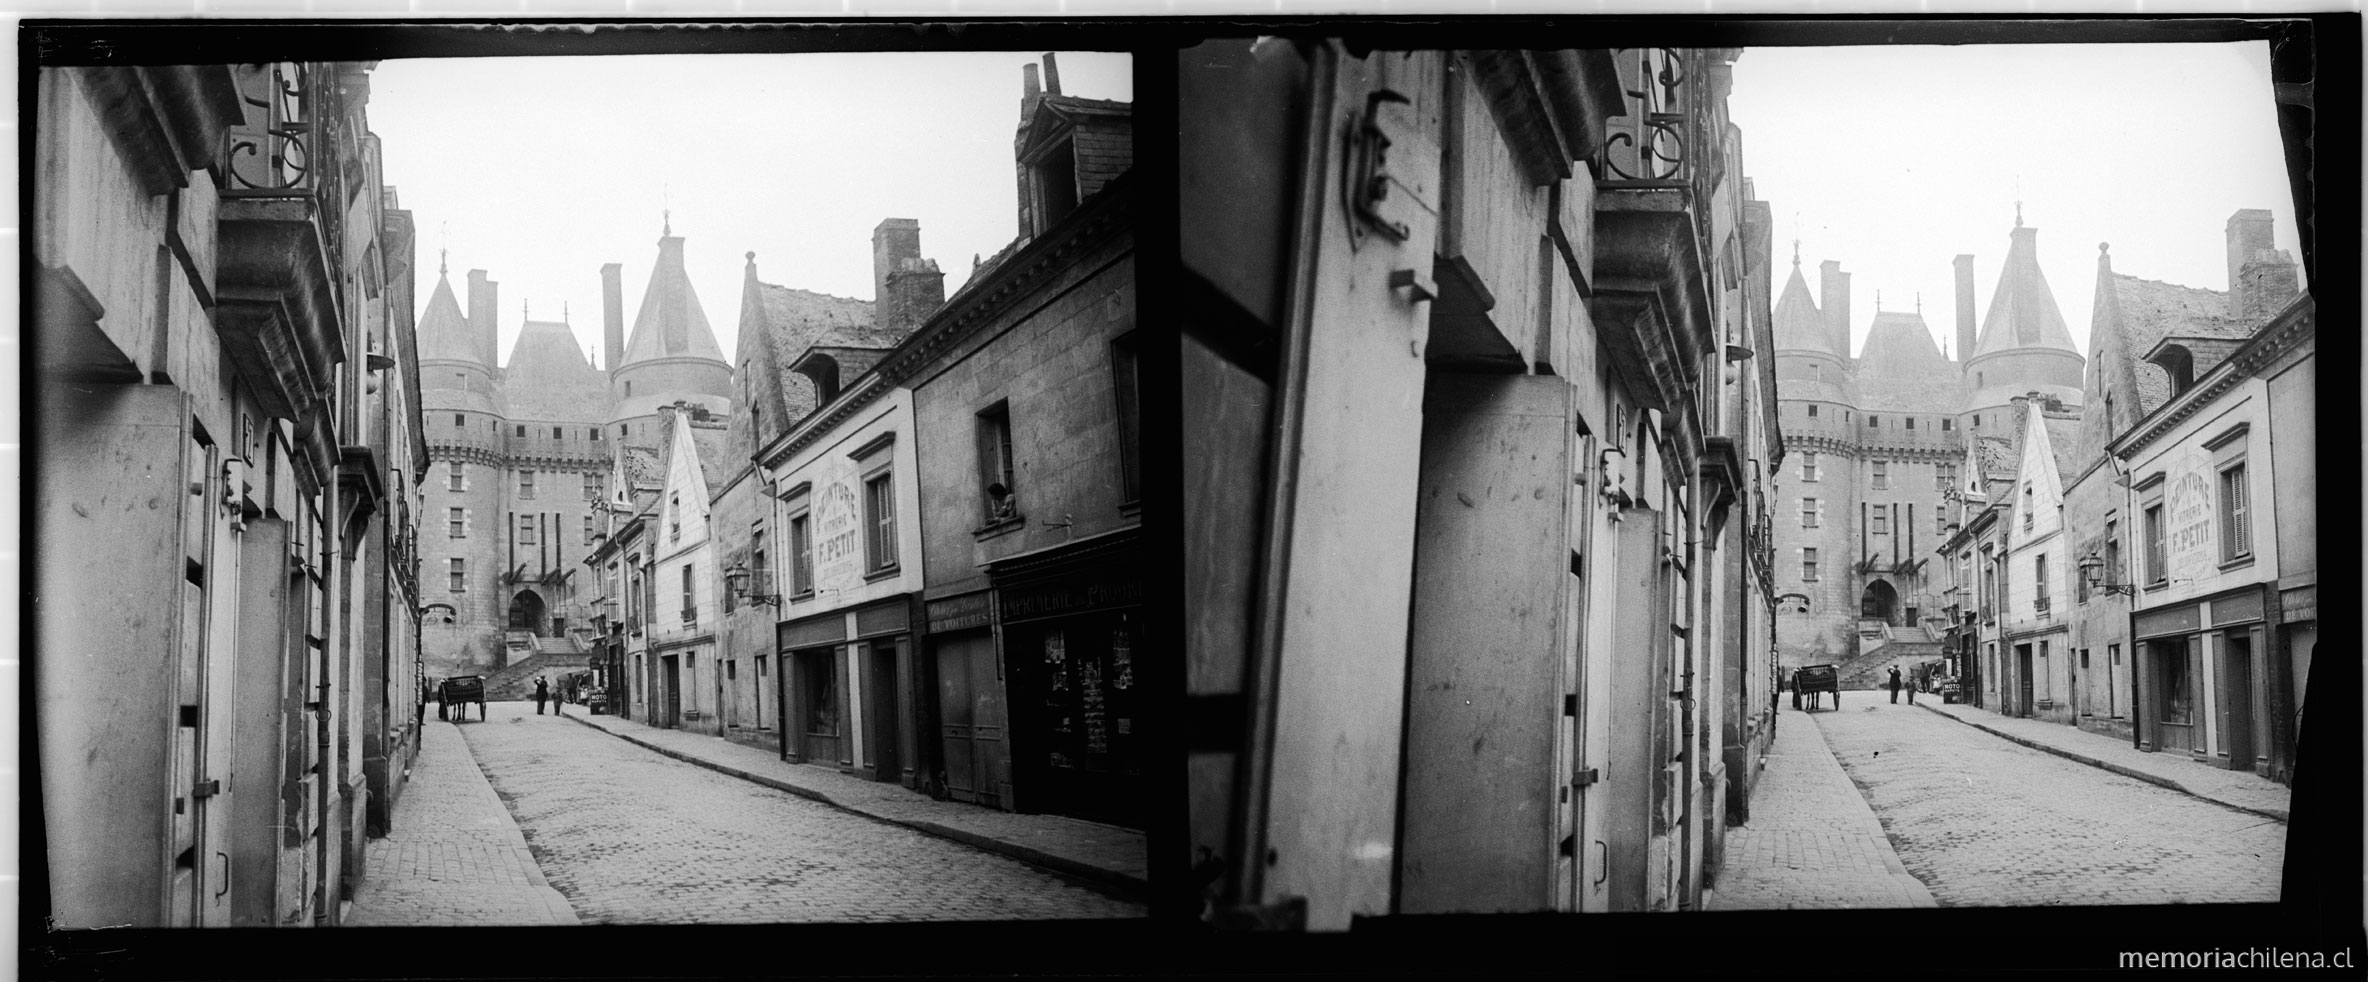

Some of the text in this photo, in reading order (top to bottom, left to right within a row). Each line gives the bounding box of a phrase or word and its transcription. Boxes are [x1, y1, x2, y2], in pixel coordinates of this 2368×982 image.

[816, 482, 856, 535] PEINTURE
[2170, 471, 2210, 526] PEINTURE
[931, 613, 988, 632] DE VOITURES
[1002, 591, 1073, 619] IMPRIMERIE
